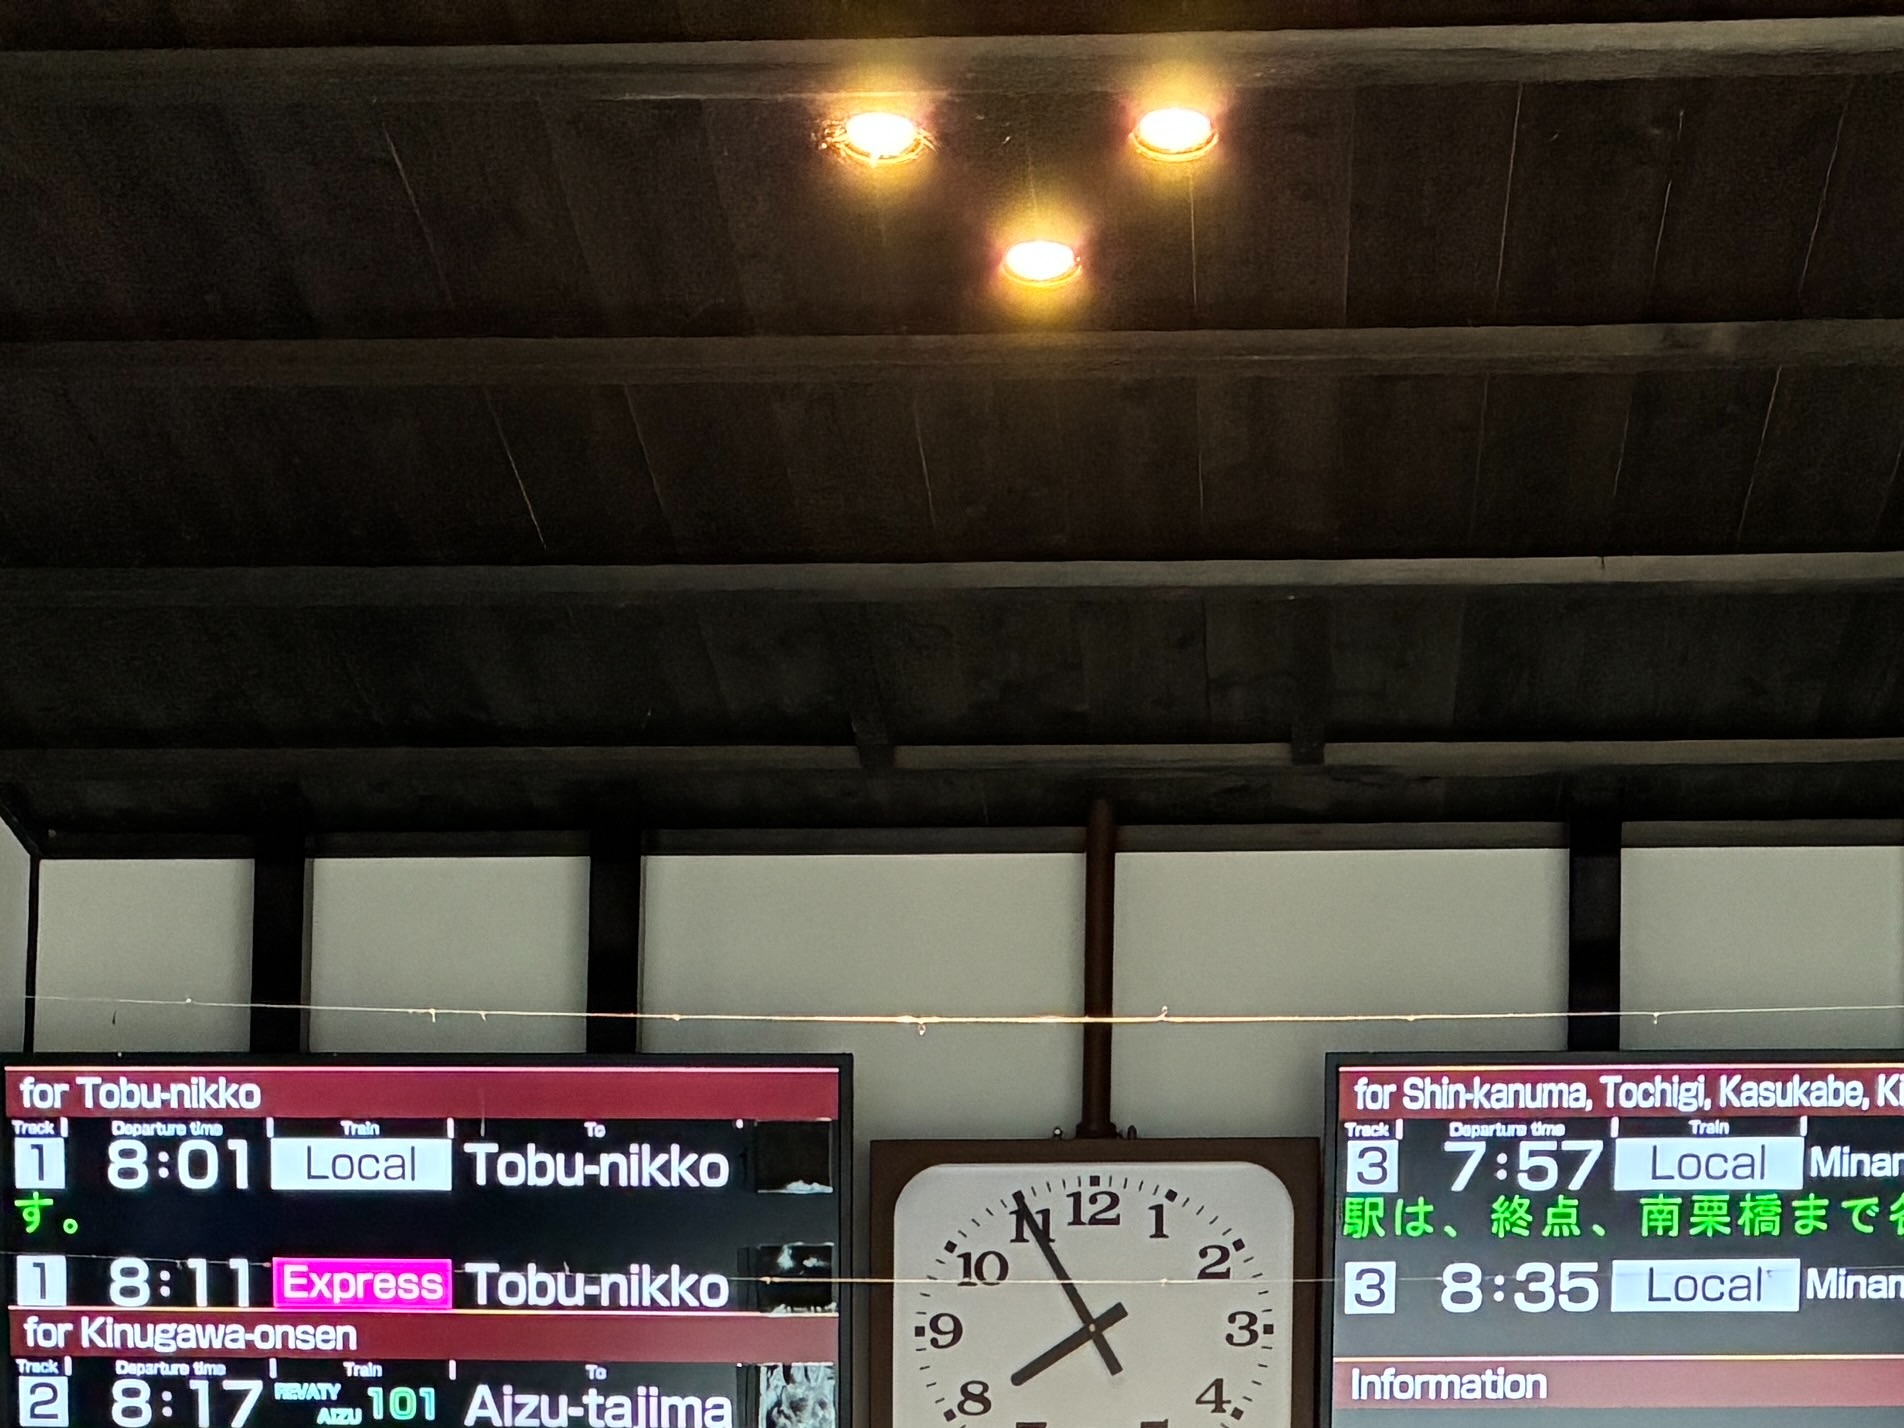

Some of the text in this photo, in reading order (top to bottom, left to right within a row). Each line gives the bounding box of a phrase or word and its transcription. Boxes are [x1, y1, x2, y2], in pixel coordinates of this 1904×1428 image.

[20, 1076, 261, 1110] for Tobu-nikko
[1354, 1076, 1396, 1109] for
[1403, 1074, 1593, 1113] Shin-kanuma,
[1600, 1074, 1712, 1113] Tochigi,
[1719, 1074, 1870, 1113] Kasukabe,
[12, 1120, 606, 1138] Track Departure time Train To
[1344, 1122, 1390, 1137] Track
[1449, 1121, 1526, 1139] Departure
[1530, 1121, 1565, 1136] time
[1689, 1119, 1729, 1135] Train
[29, 1140, 730, 1190] 1 8:01 Local Tobu-nikko
[1356, 1147, 1388, 1185] 3
[1443, 1139, 1604, 1192] 7:57
[1651, 1144, 1767, 1181] Local
[20, 1194, 80, 1237] す。
[1009, 1208, 1056, 1243] 11
[1066, 1190, 1121, 1226] 12
[1148, 1203, 1170, 1239] 1
[957, 1250, 1009, 1287] 10
[1197, 1244, 1231, 1280] 2
[30, 1257, 730, 1308] 1 8:11 Express Tobu-nikko
[1355, 1268, 1387, 1306] 3
[1441, 1261, 1600, 1313] 8:35
[1647, 1266, 1765, 1303] Local
[24, 1316, 357, 1354] for Kinugawa-onsen
[929, 1312, 963, 1349] 9
[1225, 1311, 1259, 1347] 3
[16, 1358, 607, 1380] Track Departure time Train To
[1352, 1367, 1548, 1402] Information
[29, 1386, 59, 1422] 2
[110, 1379, 264, 1428] 8:17
[273, 1382, 342, 1400] REVATY
[367, 1386, 436, 1421] 101
[956, 1380, 992, 1416] 8
[1195, 1377, 1232, 1414] 4
[316, 1407, 362, 1425] AIZU
